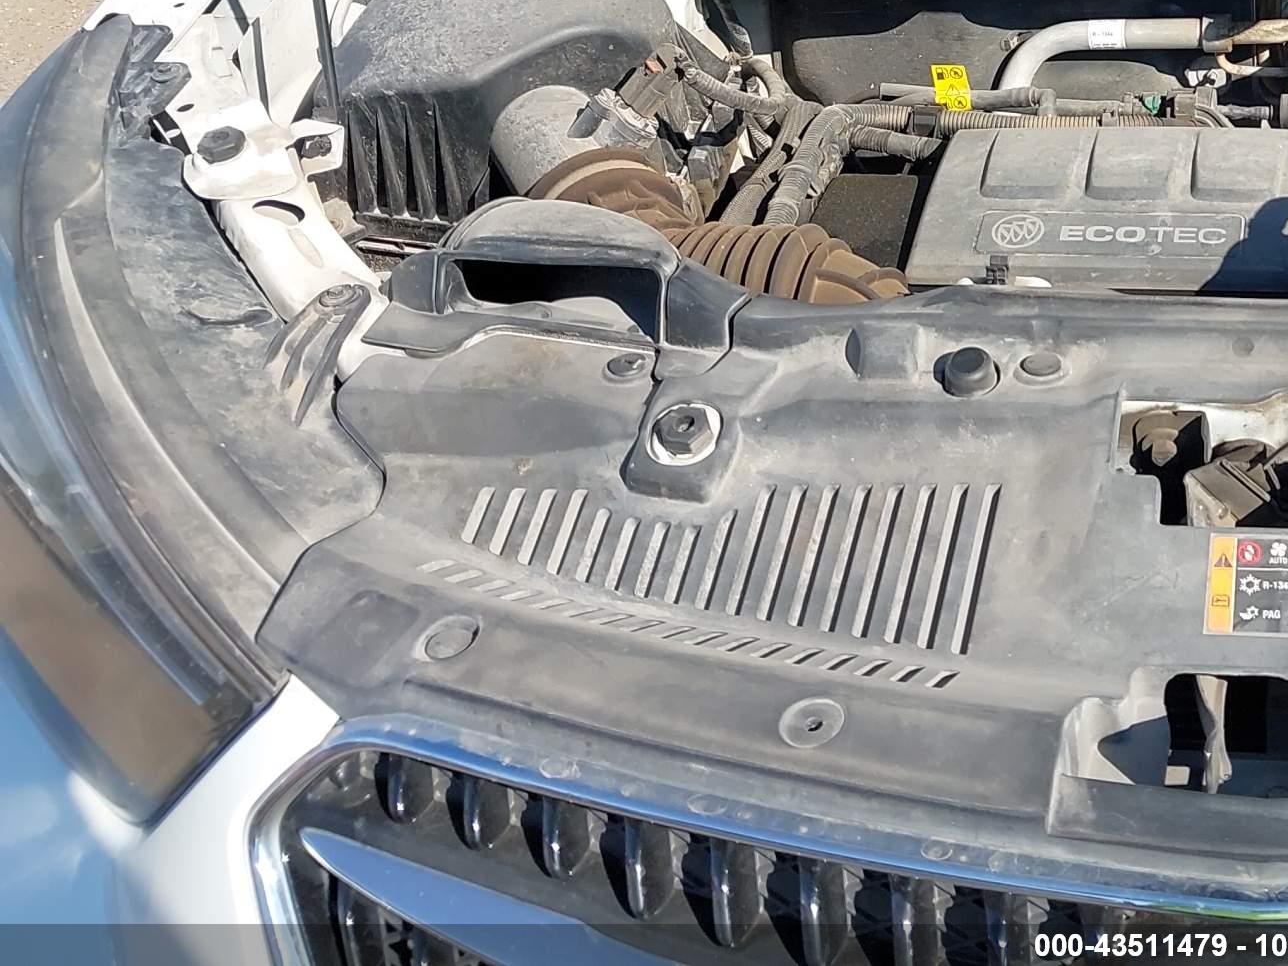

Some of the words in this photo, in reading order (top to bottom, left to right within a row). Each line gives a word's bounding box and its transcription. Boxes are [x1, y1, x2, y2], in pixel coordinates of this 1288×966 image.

[1059, 225, 1227, 244] ECOTEC
[1269, 557, 1288, 565] AUTO
[1262, 610, 1281, 619] PAG
